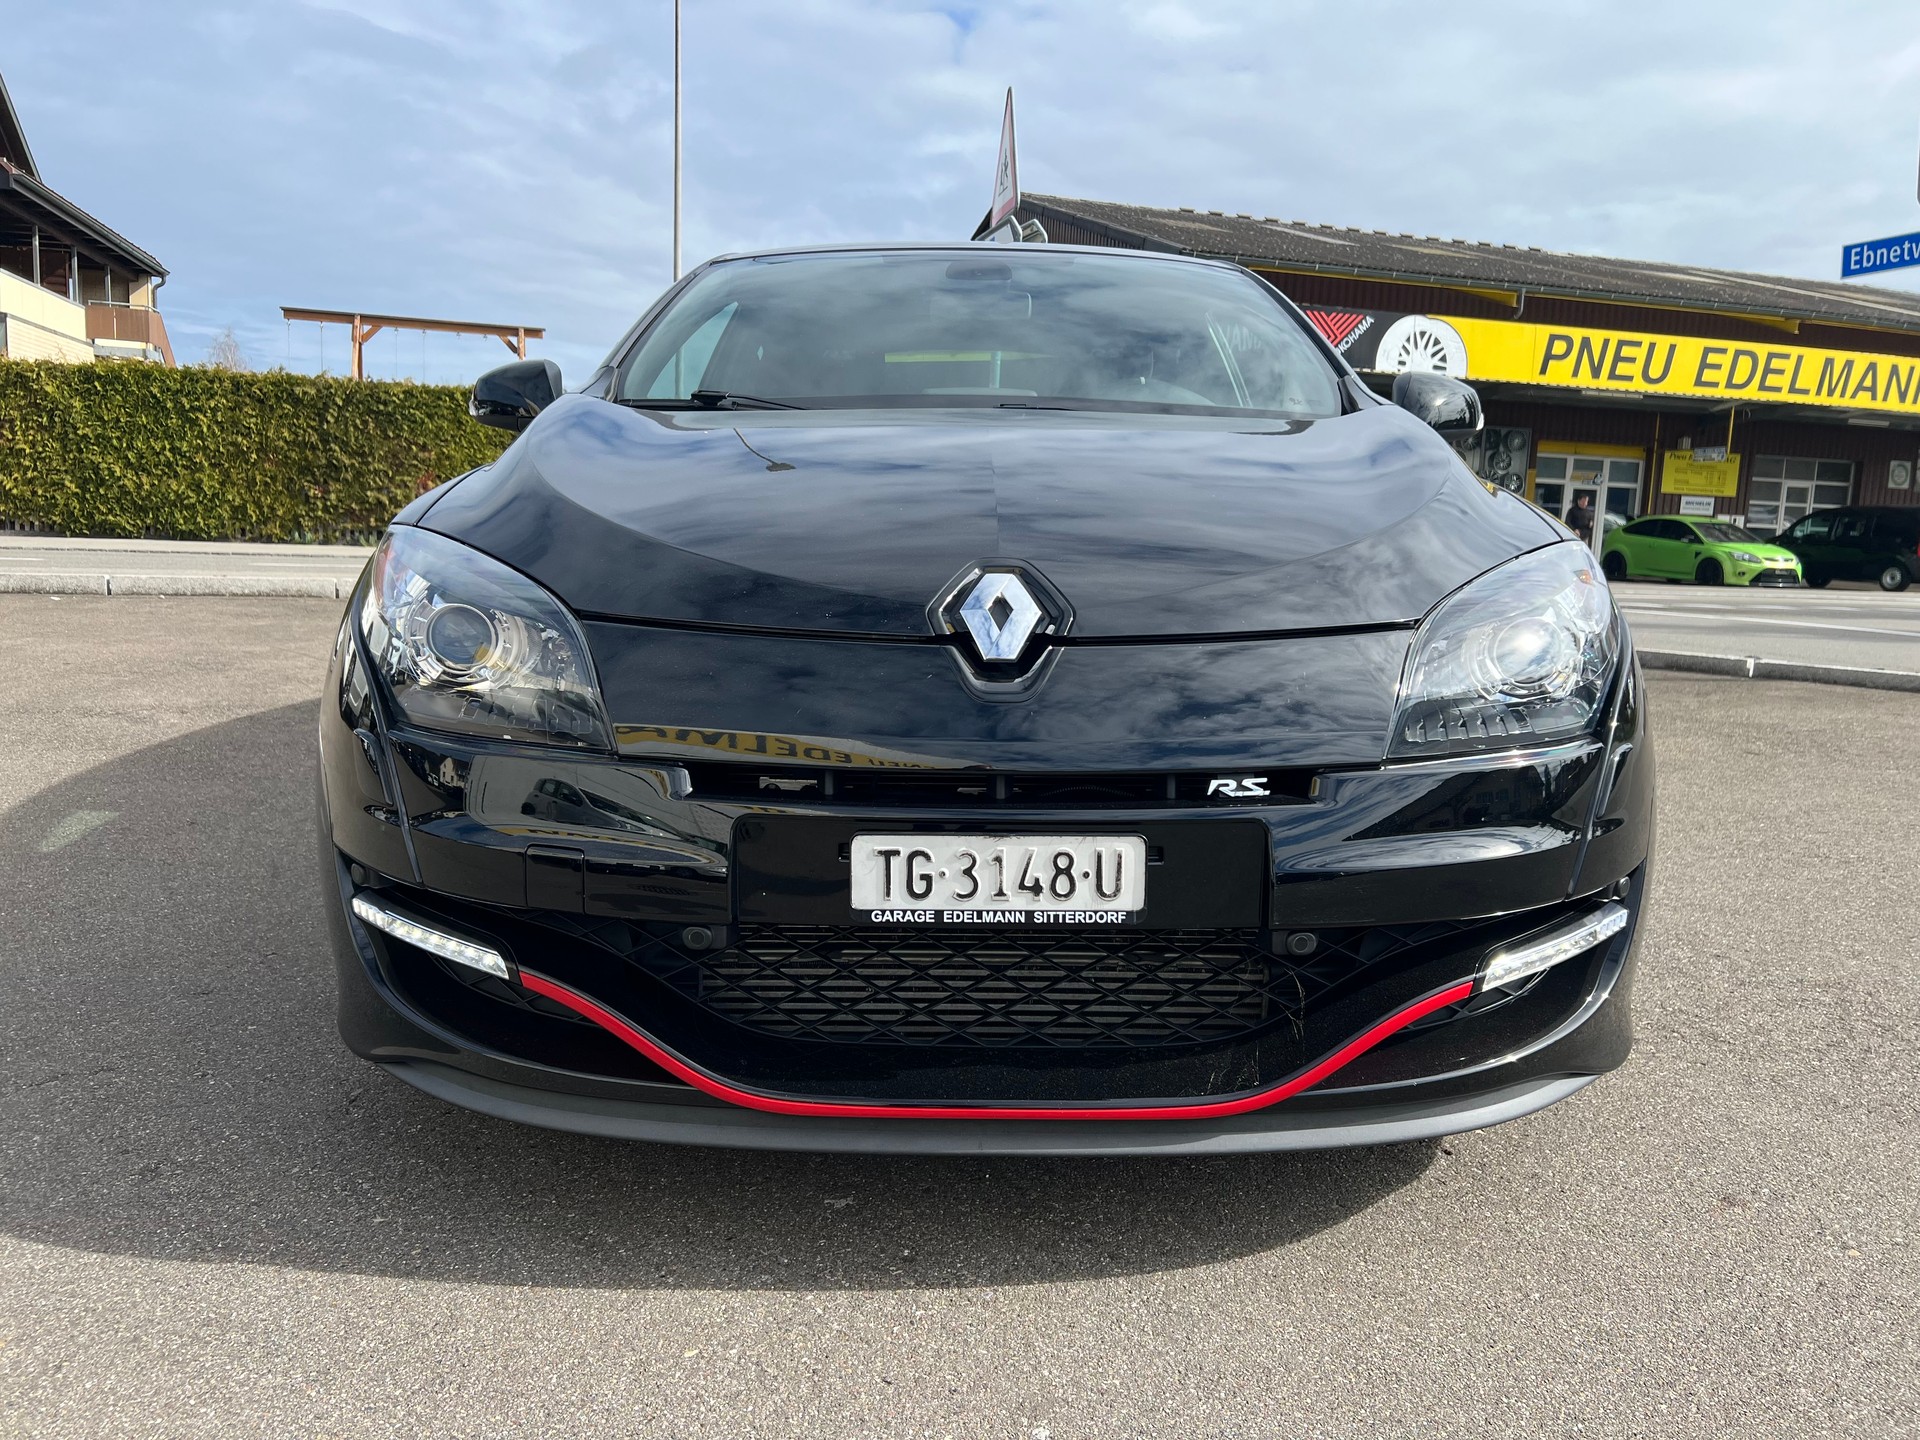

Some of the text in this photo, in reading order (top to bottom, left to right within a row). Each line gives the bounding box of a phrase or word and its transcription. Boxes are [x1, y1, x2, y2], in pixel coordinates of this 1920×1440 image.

[1335, 316, 1375, 355] KOHAMA
[1539, 333, 1920, 405] PNEU EDELMAN
[871, 910, 1127, 924] GARAGE EDELMANN SITTERDORF
